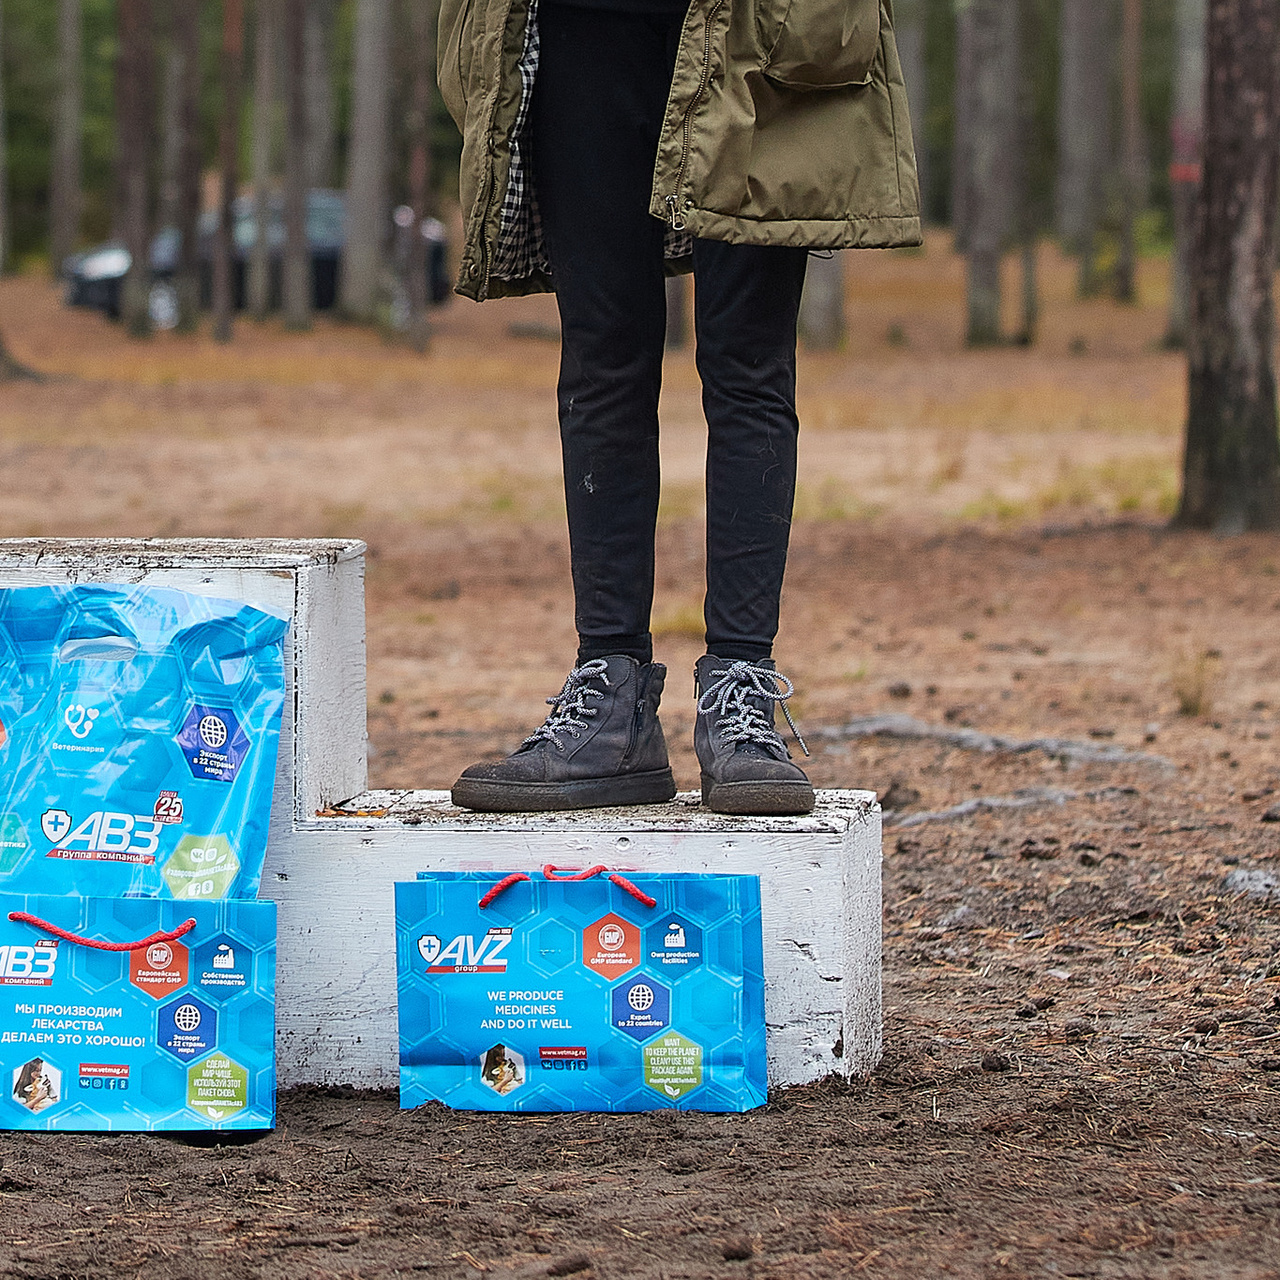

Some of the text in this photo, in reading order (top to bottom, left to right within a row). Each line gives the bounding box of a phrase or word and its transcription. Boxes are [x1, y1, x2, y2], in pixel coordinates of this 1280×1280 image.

[52, 742, 104, 753] Ветеринария
[157, 797, 182, 816] 25
[56, 811, 163, 854] АВЗ
[57, 850, 145, 862] группа компаний
[431, 935, 512, 966] AVZ
[137, 969, 180, 977] Европейский
[202, 972, 244, 980] Собственное
[487, 991, 564, 1001] WE PRODUCE
[15, 1004, 122, 1018] МЫ ПРОИЗВОДИМ
[495, 1005, 556, 1015] MEDICINES
[32, 1018, 104, 1031] ЛЕКАРСТВА
[481, 1019, 572, 1029] AND DO IT WELL
[1, 1032, 54, 1044] ДЕЛАЕМ
[57, 1035, 82, 1045] ЭТО
[85, 1036, 145, 1047] ХОРОШО!
